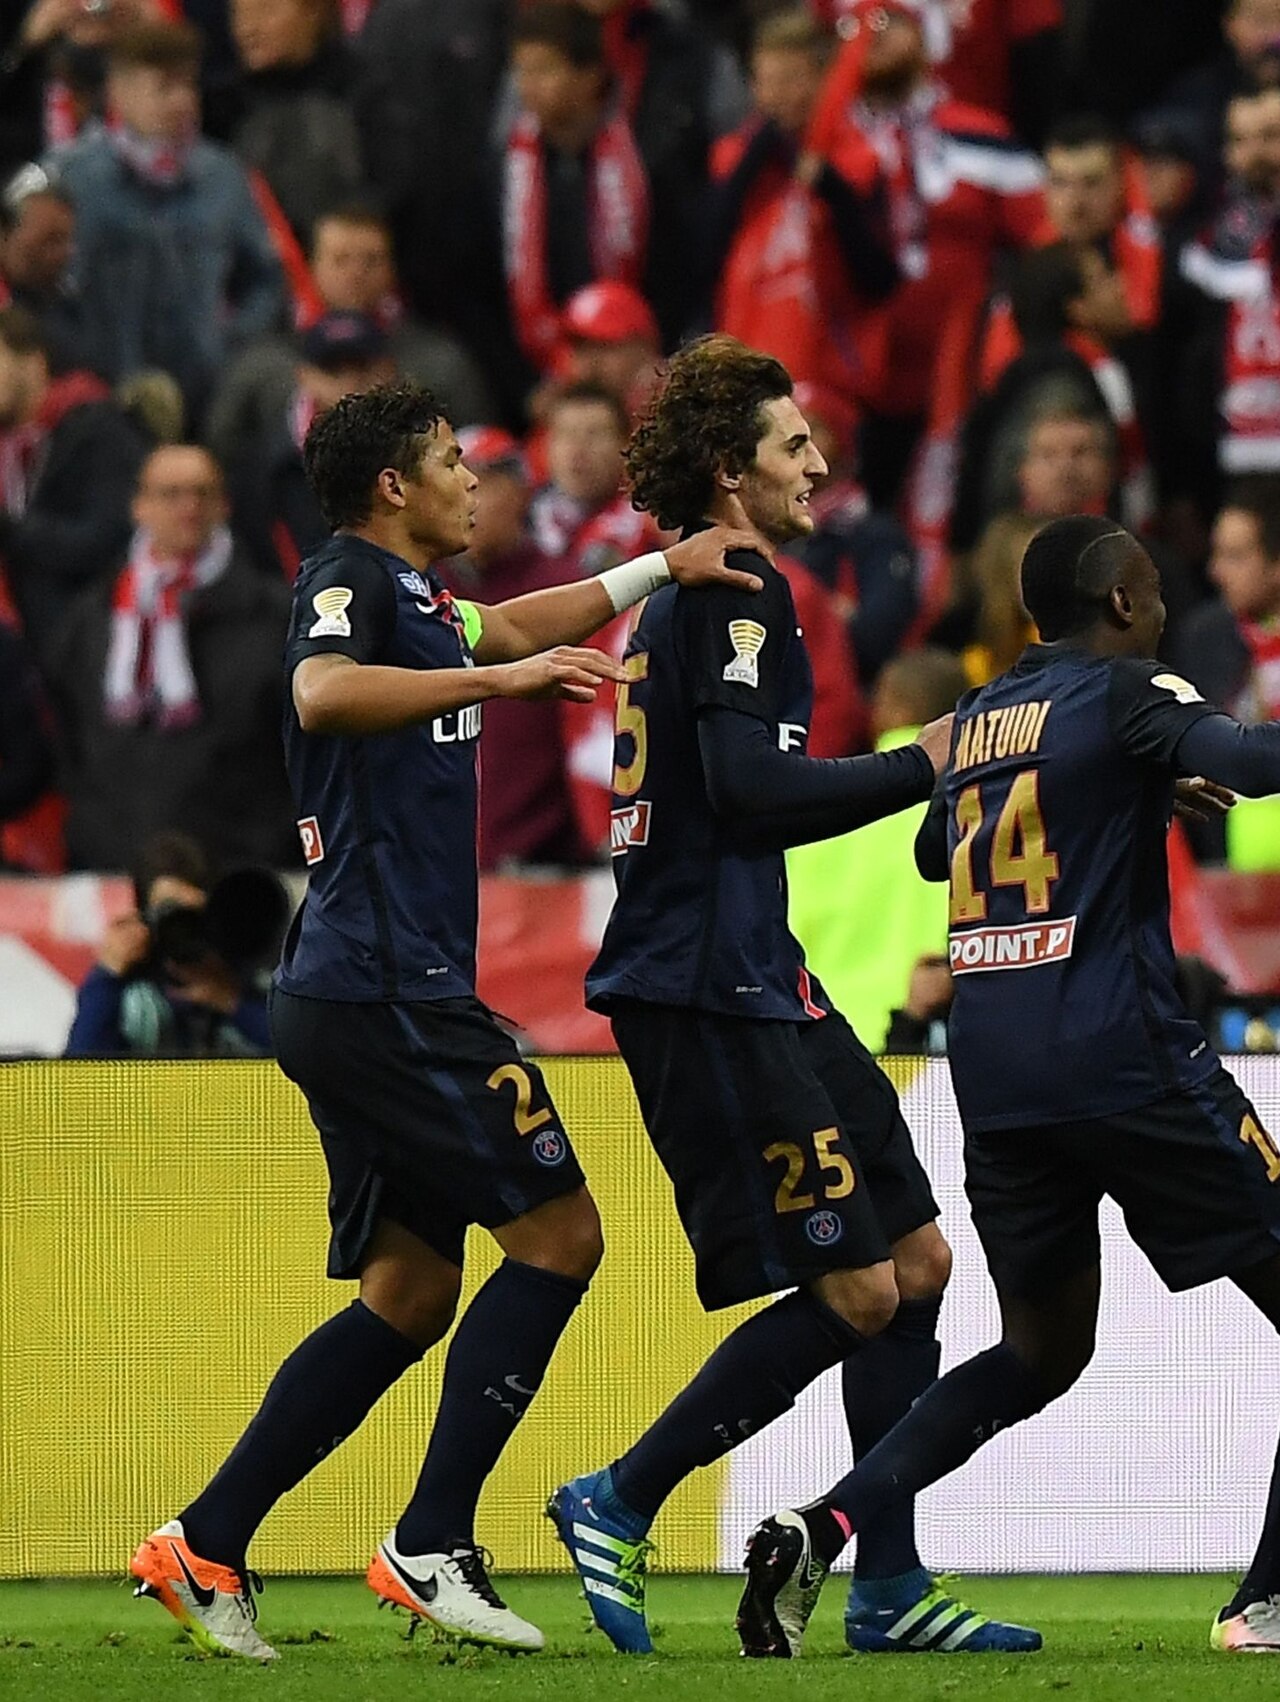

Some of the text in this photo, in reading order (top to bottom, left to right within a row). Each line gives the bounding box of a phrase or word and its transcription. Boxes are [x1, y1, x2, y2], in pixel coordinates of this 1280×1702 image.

[950, 769, 1060, 926] 14
[486, 1063, 553, 1136] 2
[763, 1126, 855, 1214] 25
